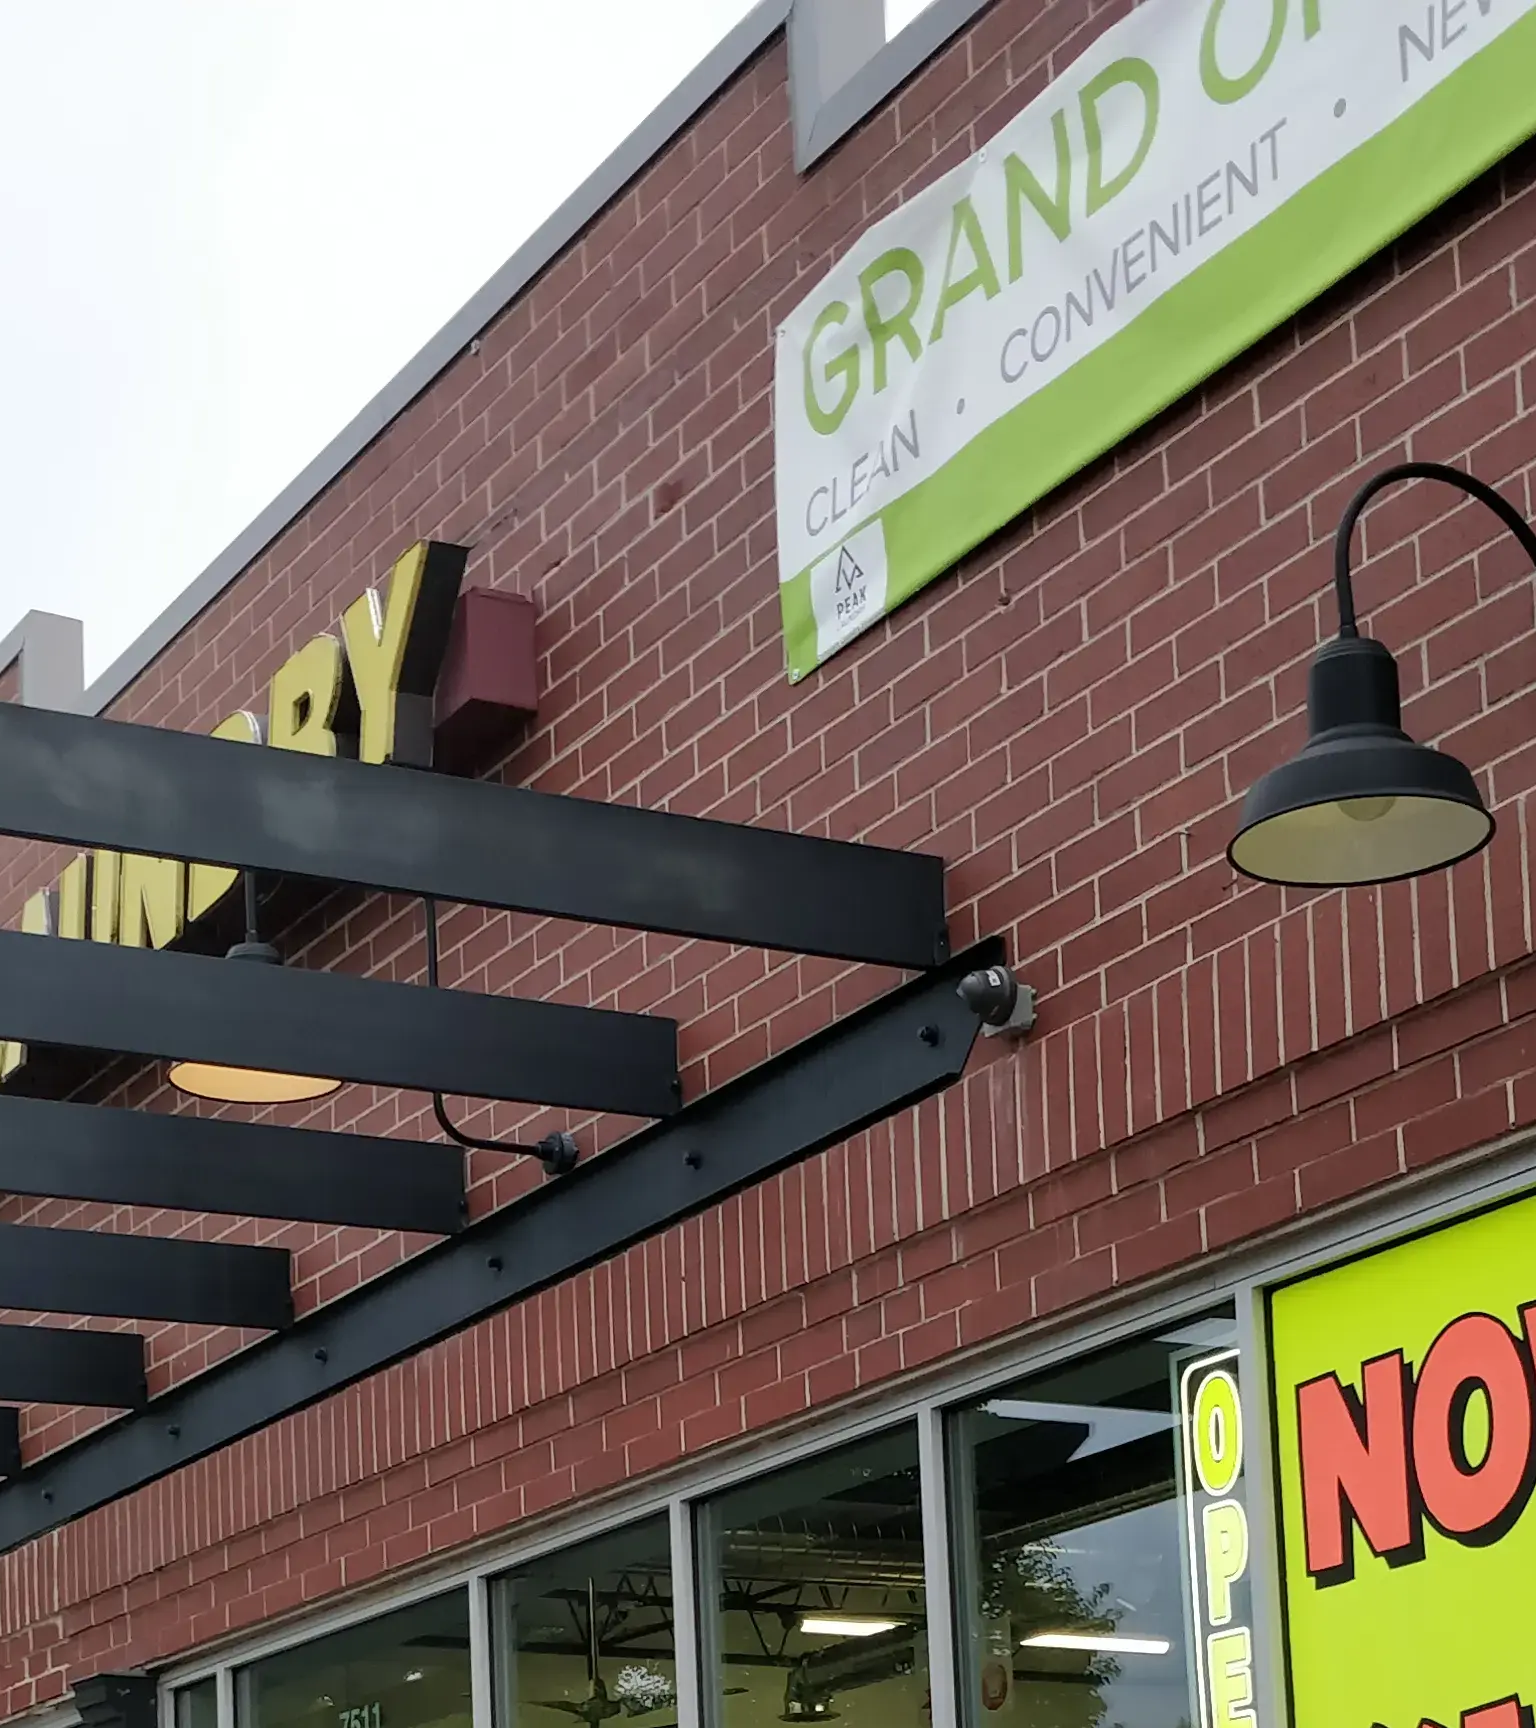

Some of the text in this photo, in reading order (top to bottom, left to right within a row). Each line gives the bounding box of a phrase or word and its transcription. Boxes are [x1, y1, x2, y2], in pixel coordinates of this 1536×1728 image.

[802, 0, 1321, 437] GRAND O
[805, 0, 1492, 538] CLEAN CONVENIENT NE
[836, 585, 868, 620] PEAK
